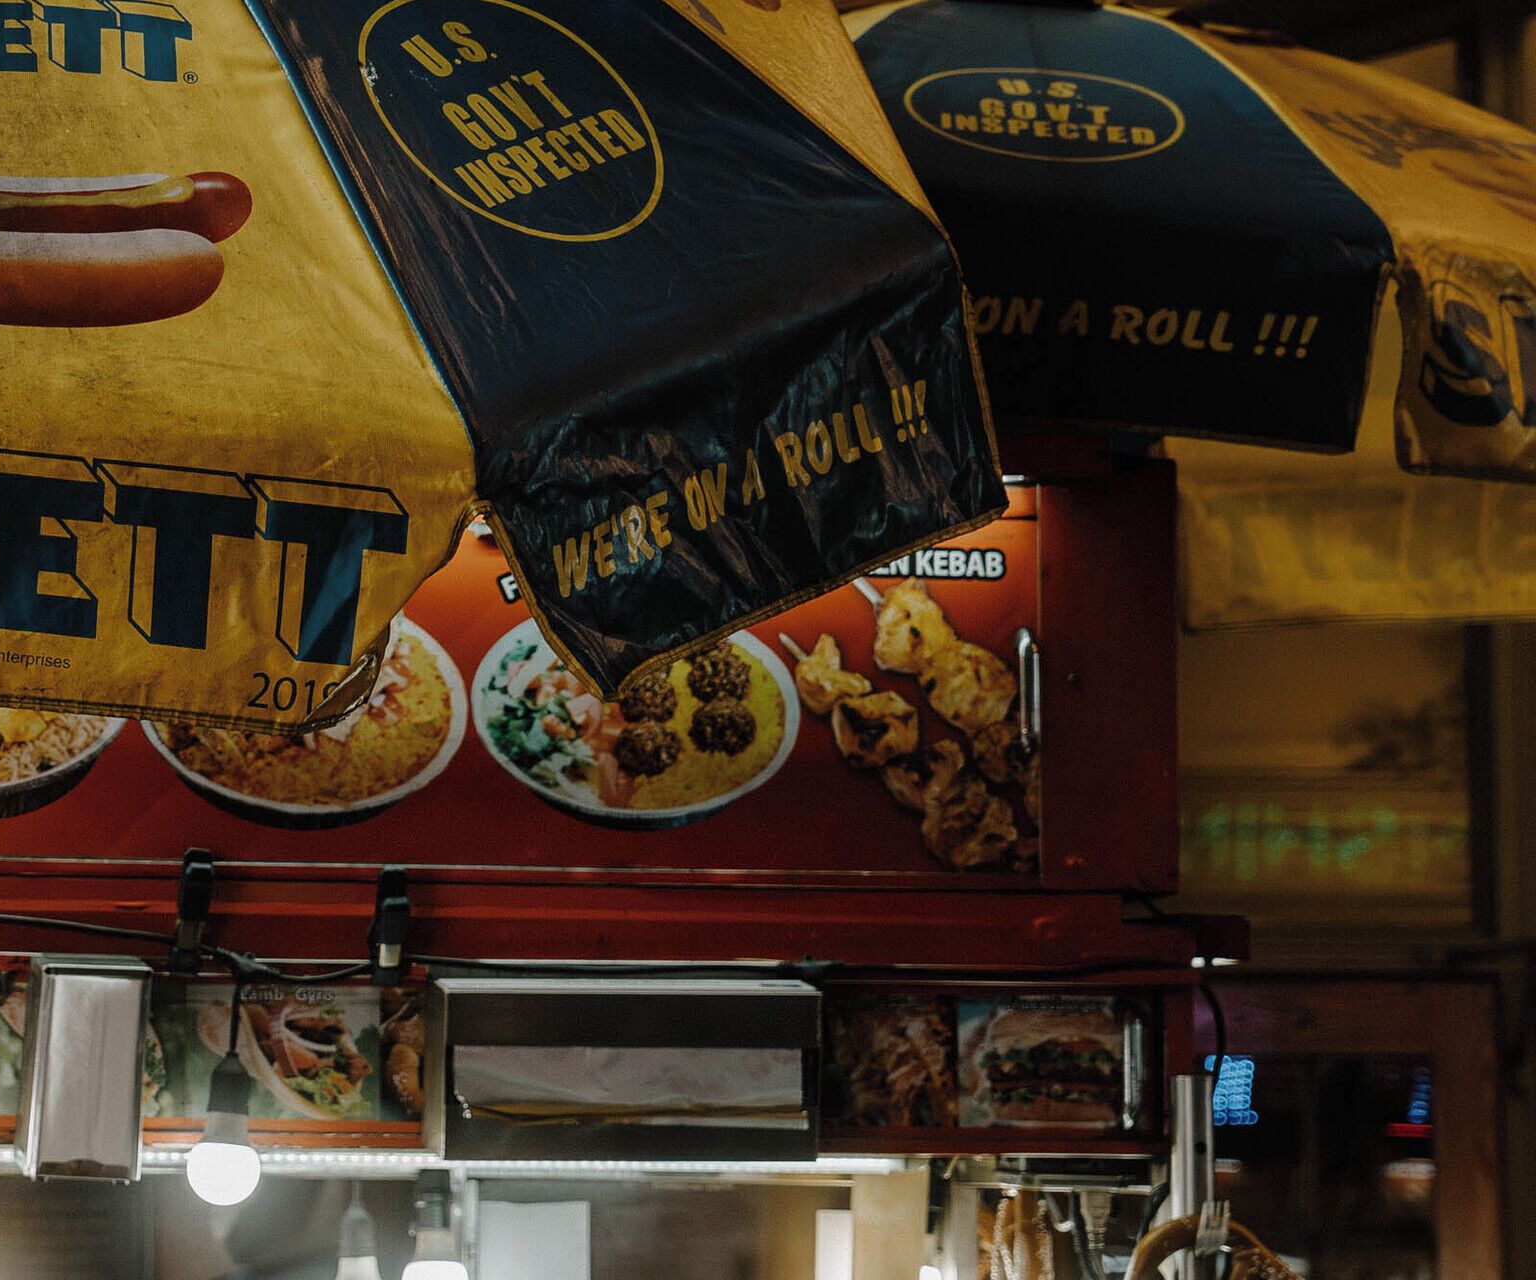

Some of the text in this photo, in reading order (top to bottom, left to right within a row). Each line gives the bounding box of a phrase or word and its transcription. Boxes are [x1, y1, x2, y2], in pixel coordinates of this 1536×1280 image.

[400, 21, 497, 77] U.S.
[442, 69, 573, 151] GOV'T
[979, 97, 1110, 125] GOV'T
[997, 78, 1082, 99] U.S.
[939, 113, 1156, 145] INSPECTED
[454, 107, 647, 208] INSPECTED
[973, 295, 1319, 359] ON A ROLL !!!
[553, 491, 672, 598] WE'RE
[684, 463, 727, 531] ON
[743, 448, 765, 506] A
[775, 403, 883, 488] ROLL
[890, 380, 927, 442] !!!
[915, 549, 1004, 578] KEBAB
